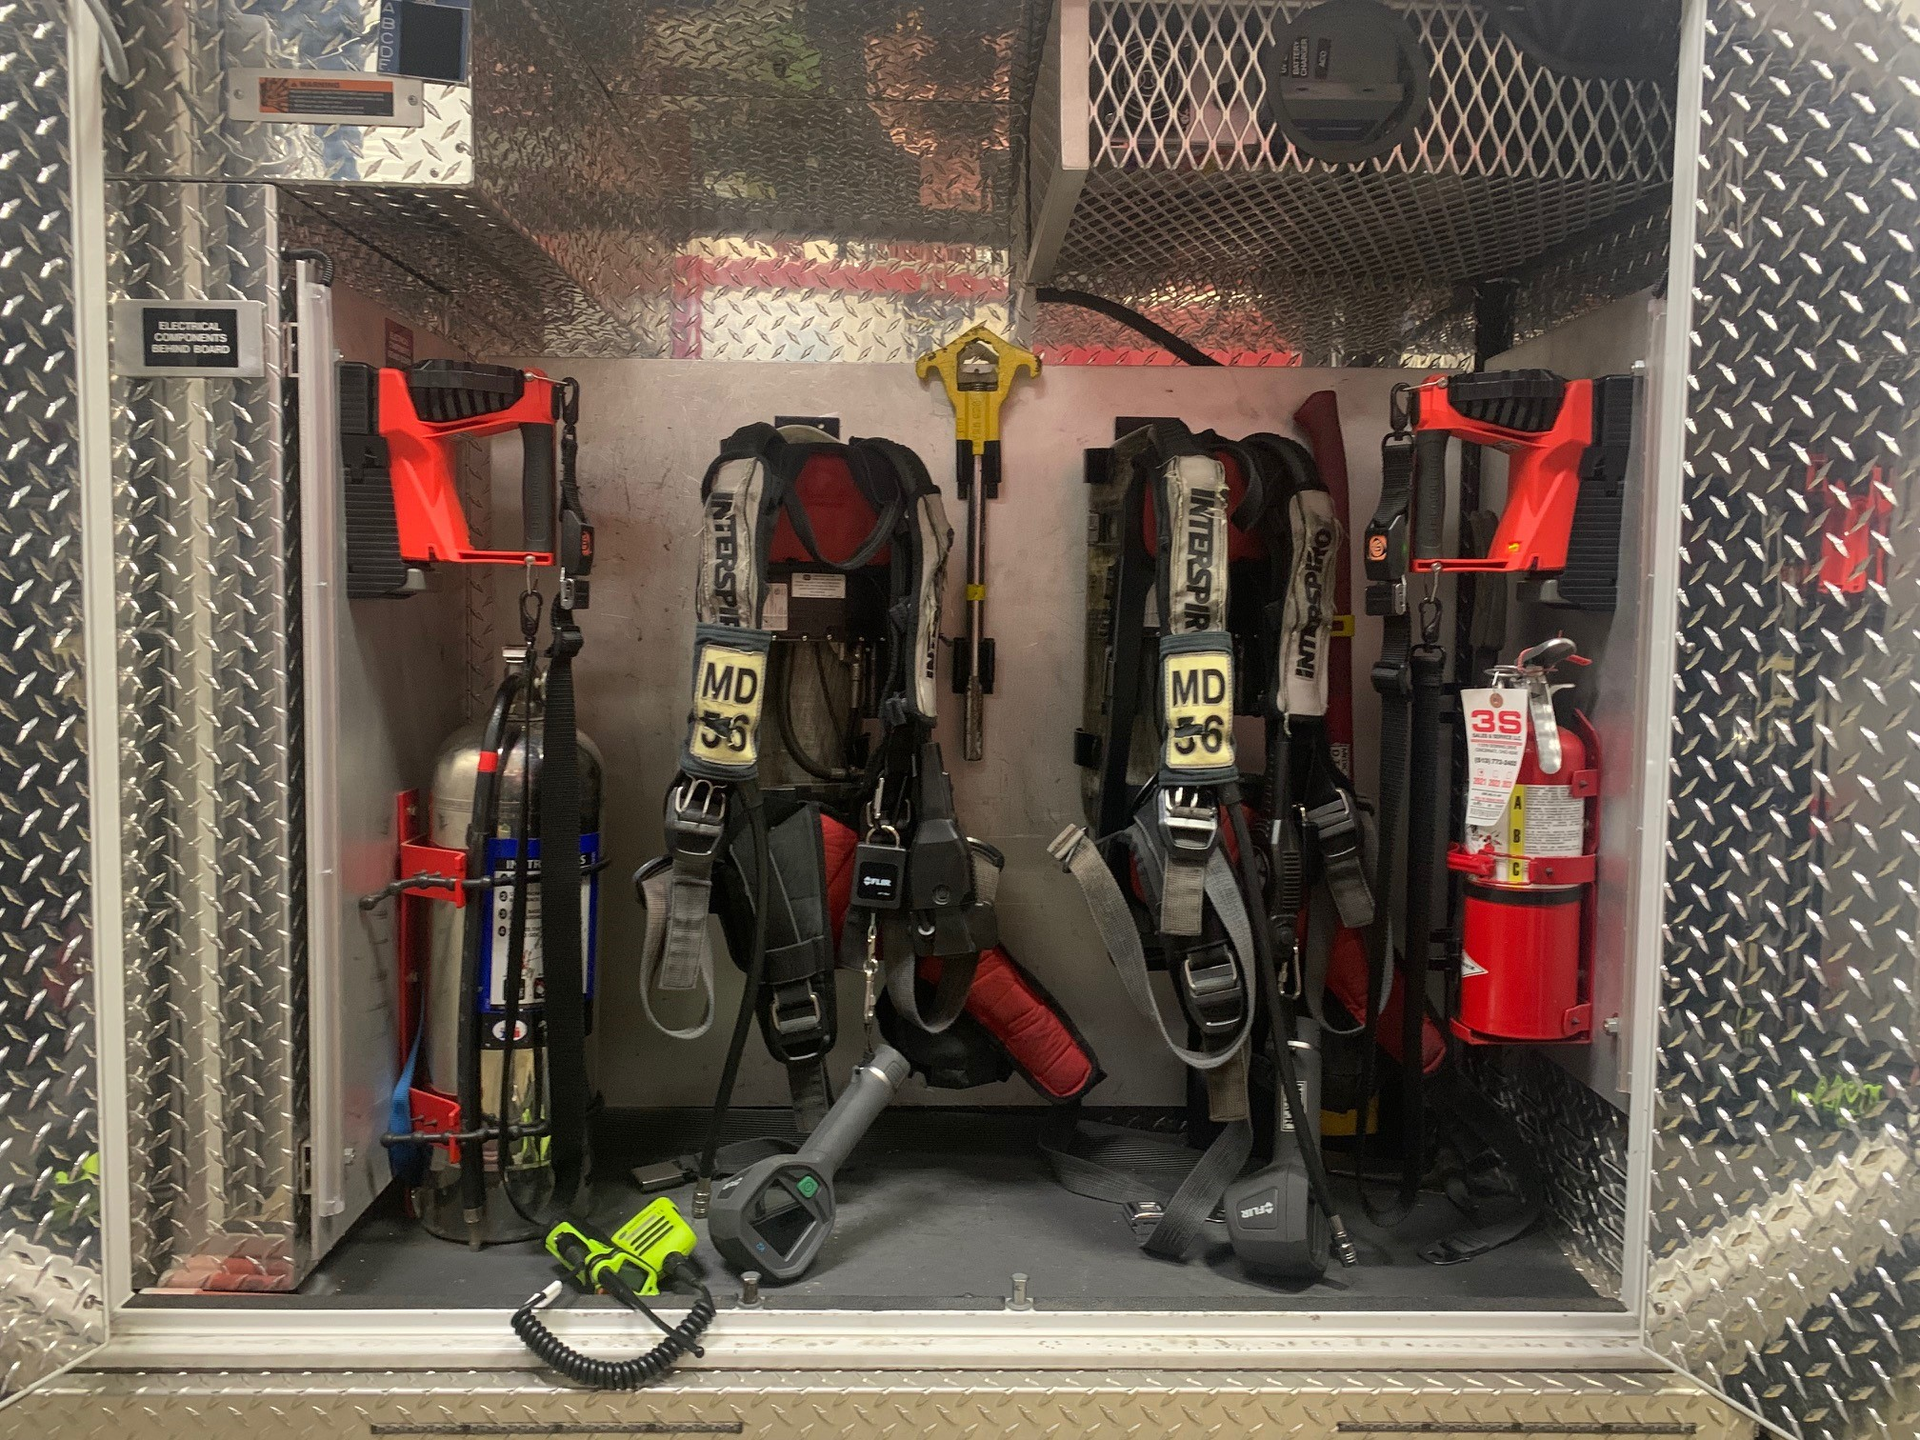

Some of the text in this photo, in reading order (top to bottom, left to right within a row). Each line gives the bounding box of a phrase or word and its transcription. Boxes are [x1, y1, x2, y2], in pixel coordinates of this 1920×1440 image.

[382, 2, 395, 14] A
[381, 18, 395, 30] B
[380, 32, 394, 44] C
[380, 46, 394, 58] D
[158, 321, 222, 331] ELECTRICAL
[154, 333, 228, 342] COMPONENTS
[151, 344, 190, 353] BEHIND
[193, 344, 230, 354] BOARD
[702, 662, 758, 704] MD
[1172, 668, 1226, 707] MD
[1471, 710, 1521, 734] 3S
[1514, 796, 1521, 810] A
[1513, 829, 1520, 843] B
[1513, 862, 1520, 876] C
[1241, 1205, 1264, 1218] FLIR
